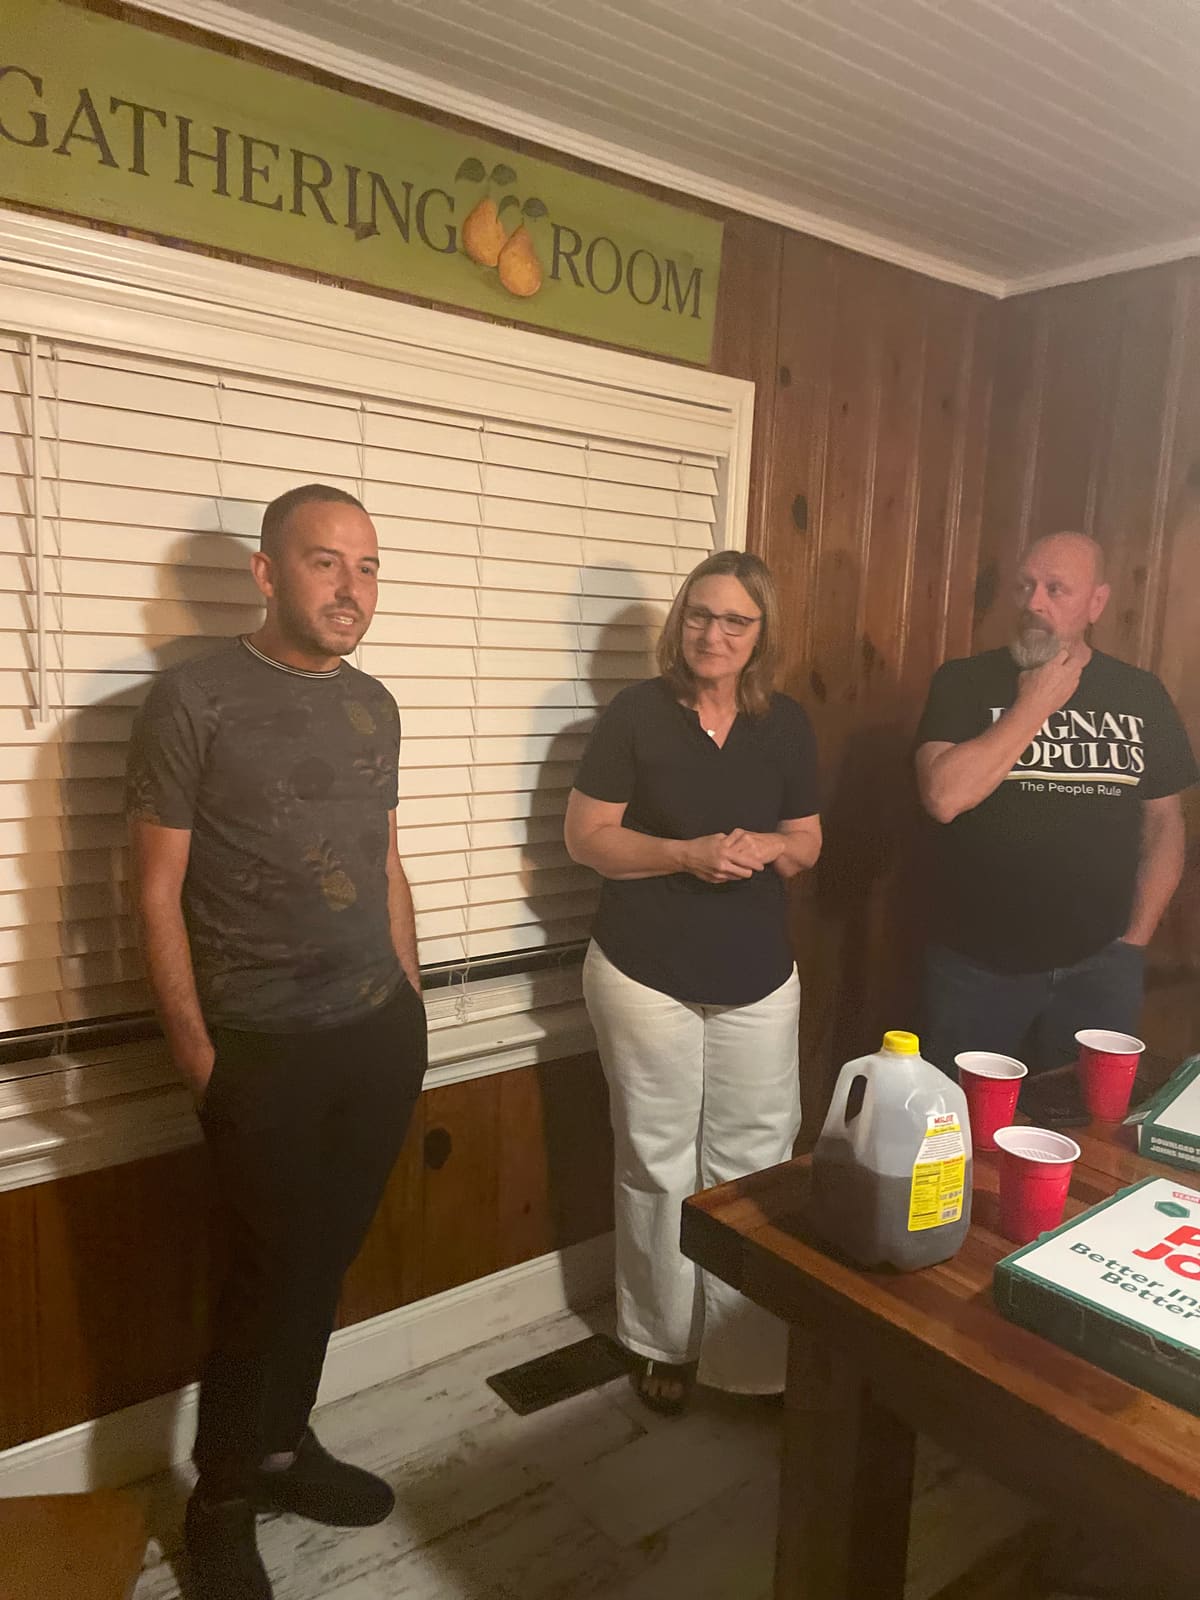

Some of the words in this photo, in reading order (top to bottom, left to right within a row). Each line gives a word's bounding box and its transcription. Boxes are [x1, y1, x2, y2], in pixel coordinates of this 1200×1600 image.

[0, 66, 457, 254] GATHERING
[550, 223, 703, 319] ROOM
[989, 708, 1144, 743] GNAT
[1016, 740, 1144, 773] OPULUS
[1020, 781, 1044, 792] The
[1048, 783, 1093, 796] People
[1097, 784, 1122, 796] Rule
[1069, 1242, 1164, 1287] Better
[1168, 1289, 1200, 1313] In
[1100, 1271, 1200, 1318] Better
